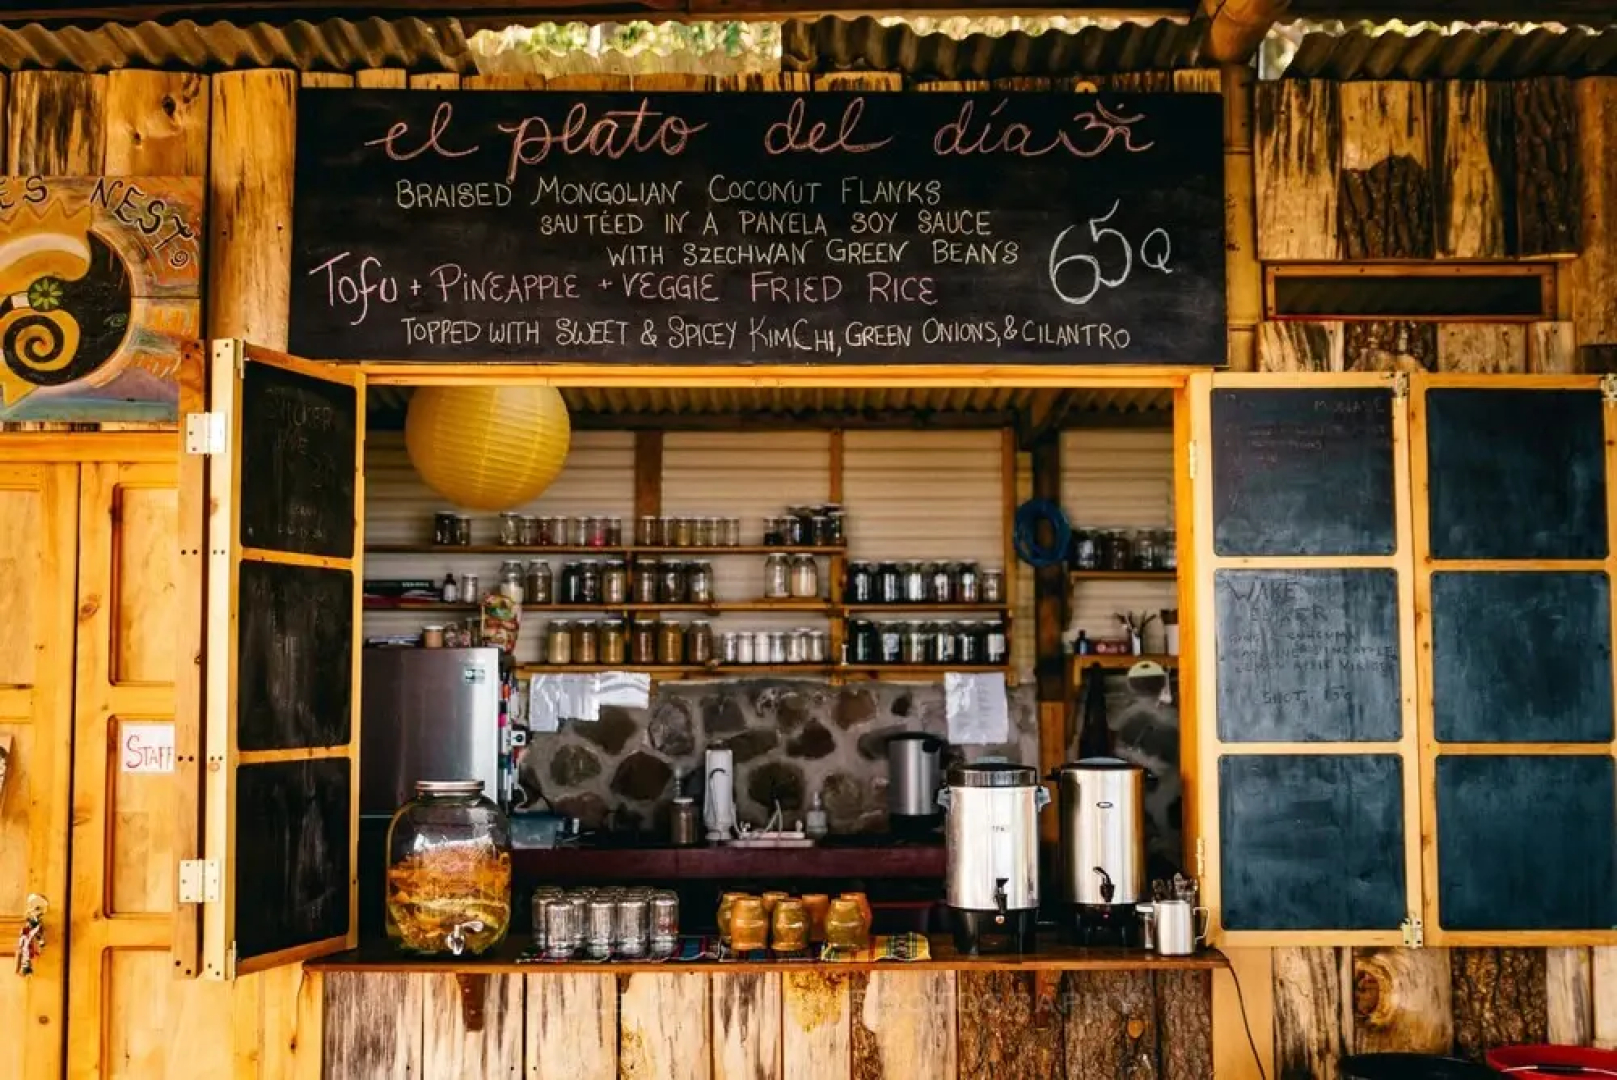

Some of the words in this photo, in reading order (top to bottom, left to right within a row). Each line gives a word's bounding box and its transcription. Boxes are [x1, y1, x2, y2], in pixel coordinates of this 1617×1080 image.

[365, 101, 478, 161] el
[497, 96, 708, 184] plato
[764, 96, 892, 155] del
[933, 98, 1062, 156] día
[396, 179, 512, 209] BRAISED
[530, 175, 683, 206] MONGOLIAN
[707, 174, 822, 205] COCONUT
[841, 176, 942, 206] FLANKS
[90, 178, 194, 251] NEST
[665, 211, 690, 234] IN
[702, 211, 719, 236] A
[738, 210, 827, 236] PANELA
[850, 211, 898, 234] SOY
[917, 210, 991, 236] SAUCE
[606, 244, 665, 267] WITH
[683, 241, 814, 266] SZECHWAN
[826, 239, 909, 265] GREEN
[932, 239, 1019, 265] BEANS
[622, 271, 719, 302] VEGGIE
[751, 271, 843, 303] FRIED
[867, 272, 938, 305] RICE
[400, 316, 480, 345] TOPPED
[488, 320, 540, 344] WITH
[555, 317, 629, 346] SWEET
[640, 319, 658, 347] &
[667, 316, 737, 349] SPICEY
[845, 321, 912, 347] GREEN
[1003, 314, 1018, 340] &
[1022, 320, 1131, 349] CILANTRO
